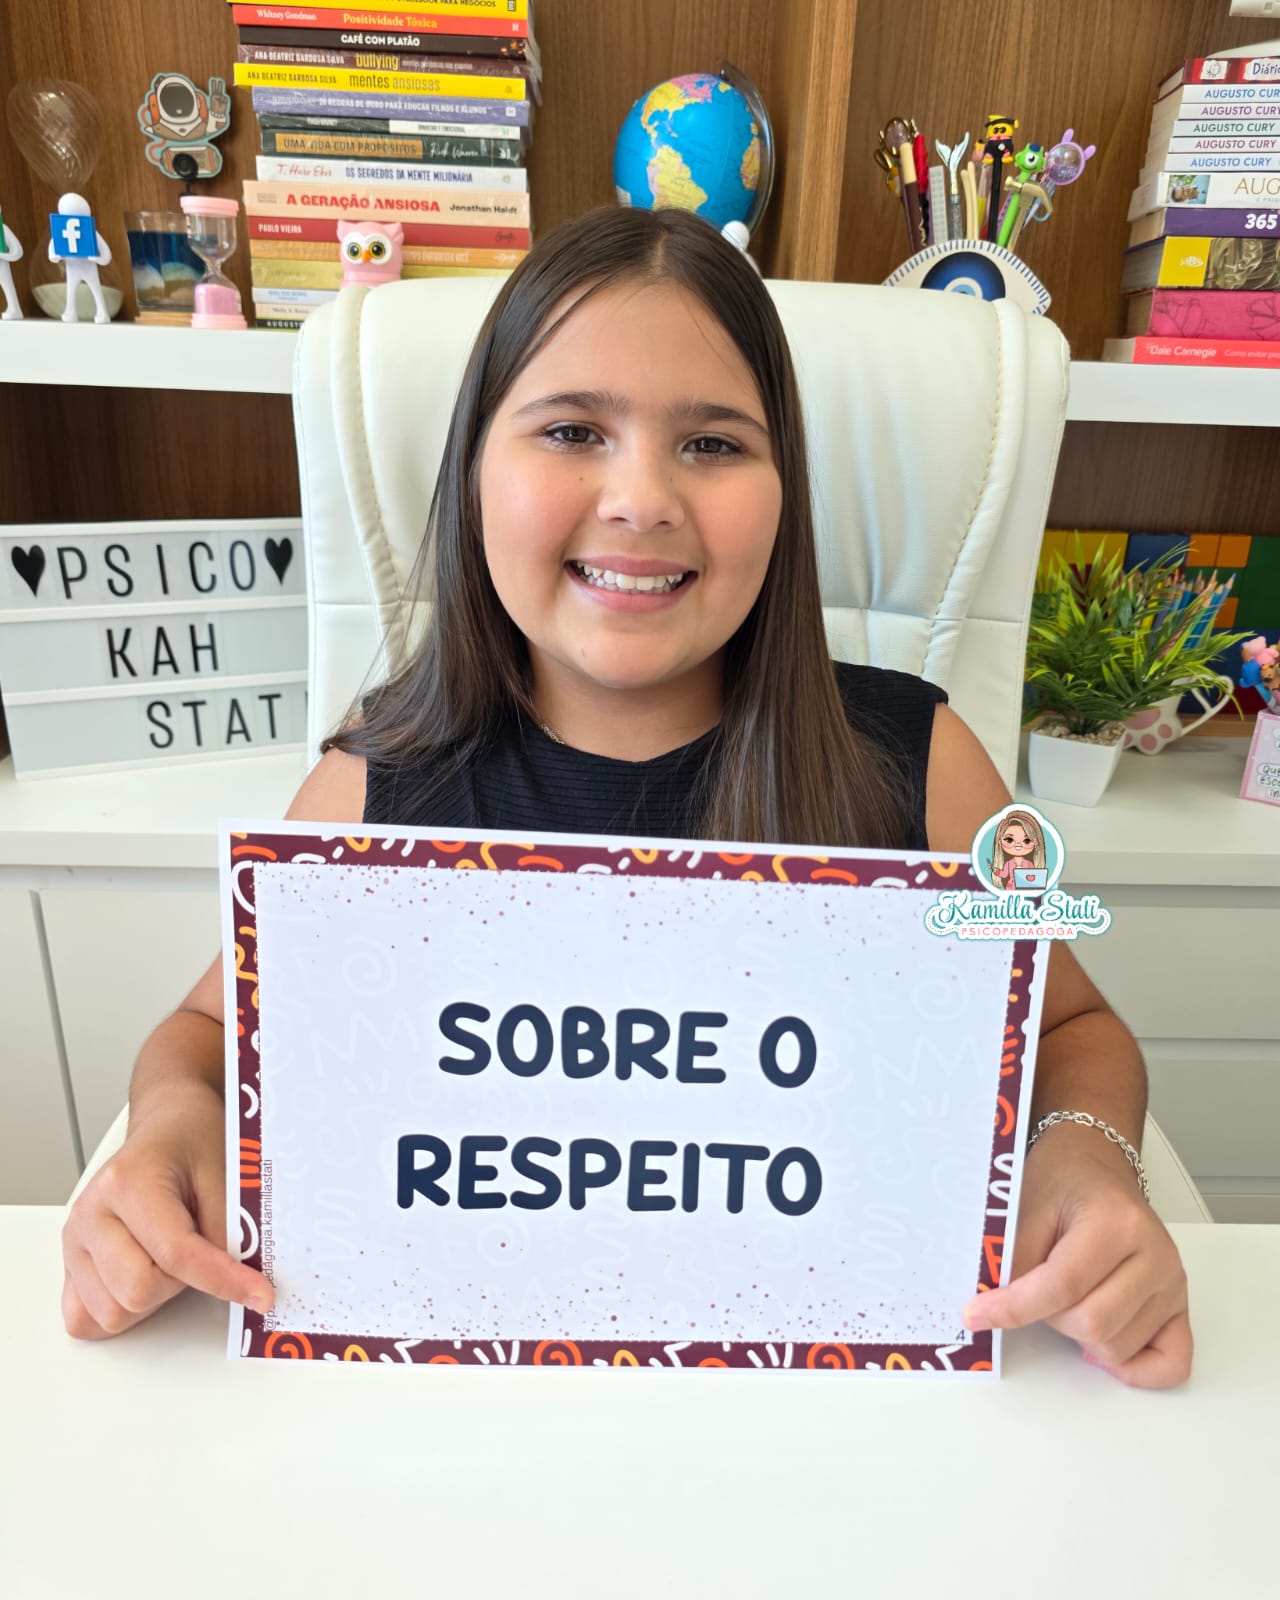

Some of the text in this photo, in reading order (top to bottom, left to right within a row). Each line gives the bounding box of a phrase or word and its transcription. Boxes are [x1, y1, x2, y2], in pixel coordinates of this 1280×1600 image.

[343, 13, 438, 28] Positividade Tóxica
[340, 32, 420, 47] CAFÉ COM PLATÃO
[255, 51, 345, 64] ANA BEATRIZ BARBOSA SILVA
[355, 52, 399, 71] bullying
[248, 71, 337, 84] ANA BEATRIZ BARBOSA SILVA
[349, 74, 440, 91] mentes ansiosas
[1204, 89, 1255, 98] AUGUSTO
[355, 100, 364, 108] DE
[403, 102, 430, 111] EDUCAR
[431, 103, 455, 113] FILHOS
[455, 105, 460, 113] E
[1201, 106, 1252, 116] AUGUSTO
[1193, 123, 1276, 133] AUGUSTO CURY
[283, 138, 306, 149] UMA
[309, 139, 331, 150] VIDA
[333, 141, 355, 151] COM
[1195, 139, 1277, 149] AUGUSTO CURY
[1190, 157, 1272, 167] AUGUSTO CURY
[345, 167, 473, 183] OS SEGREDOS DA MENTE MILIONÁRIA
[286, 194, 298, 206] A
[300, 193, 370, 210] GERAÇÃO
[374, 198, 441, 212] ANSIOSA
[449, 204, 518, 214] Jonathan Haidt
[258, 223, 302, 233] PAULO VIEIRA
[1244, 213, 1279, 230] 365
[62, 218, 81, 253] f
[267, 320, 302, 328] AUGUST
[1149, 345, 1217, 359] Dale Carnegie
[57, 540, 256, 600] PSICO
[106, 623, 219, 678] KAH
[146, 690, 308, 749] STAT
[438, 1001, 817, 1088] SOBRE O
[397, 1133, 822, 1217] RESPEITO
[955, 1329, 966, 1342] 4
